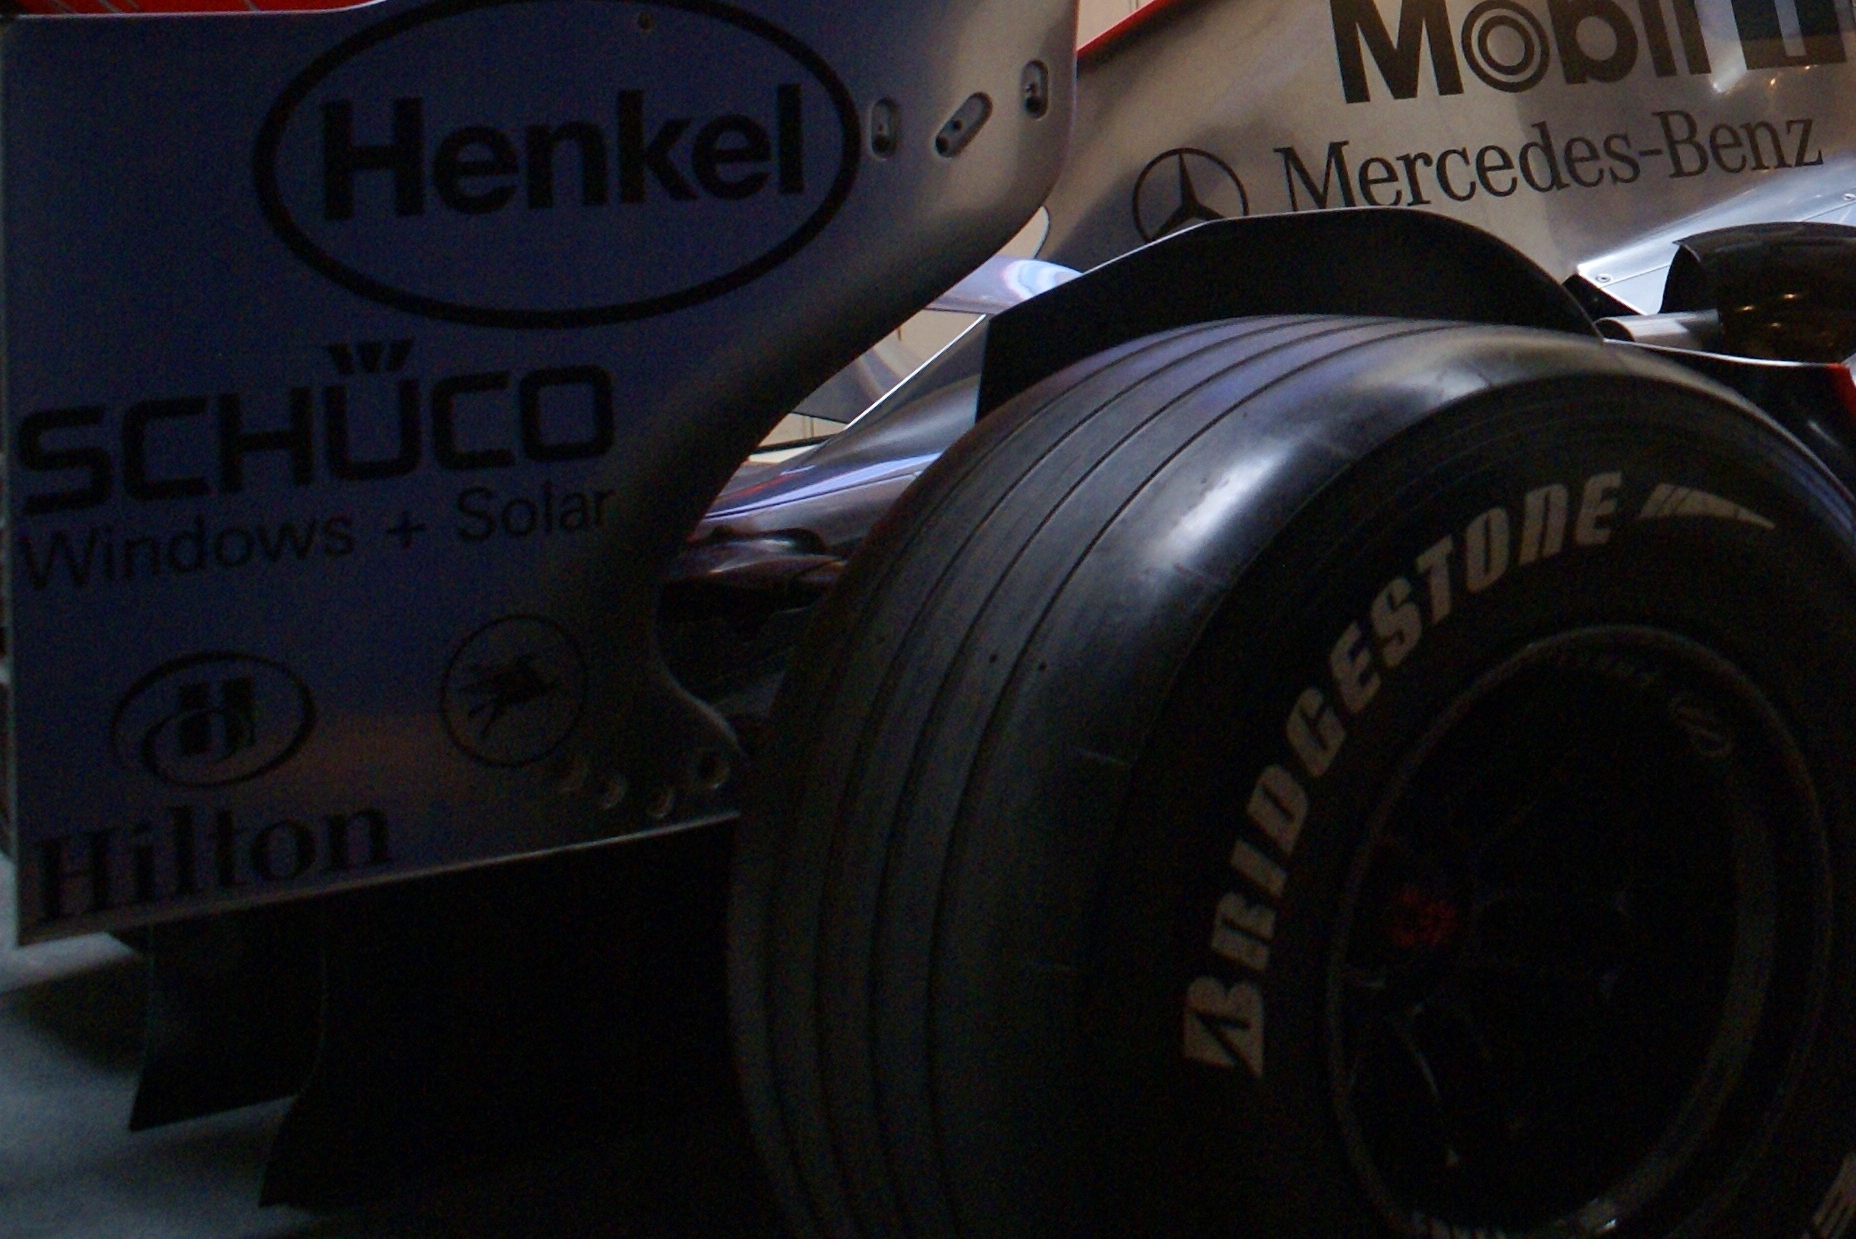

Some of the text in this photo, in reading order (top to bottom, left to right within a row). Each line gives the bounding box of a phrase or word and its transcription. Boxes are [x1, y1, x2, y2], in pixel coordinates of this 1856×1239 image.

[319, 83, 807, 223] Henkel
[1273, 109, 1824, 209] Mercedes-Benz
[17, 339, 617, 515] SCHÜCO
[20, 509, 356, 592] Windows
[457, 480, 616, 543] Solar
[1183, 471, 1623, 1080] BRIDGESTONE
[30, 804, 395, 922] Hilton
